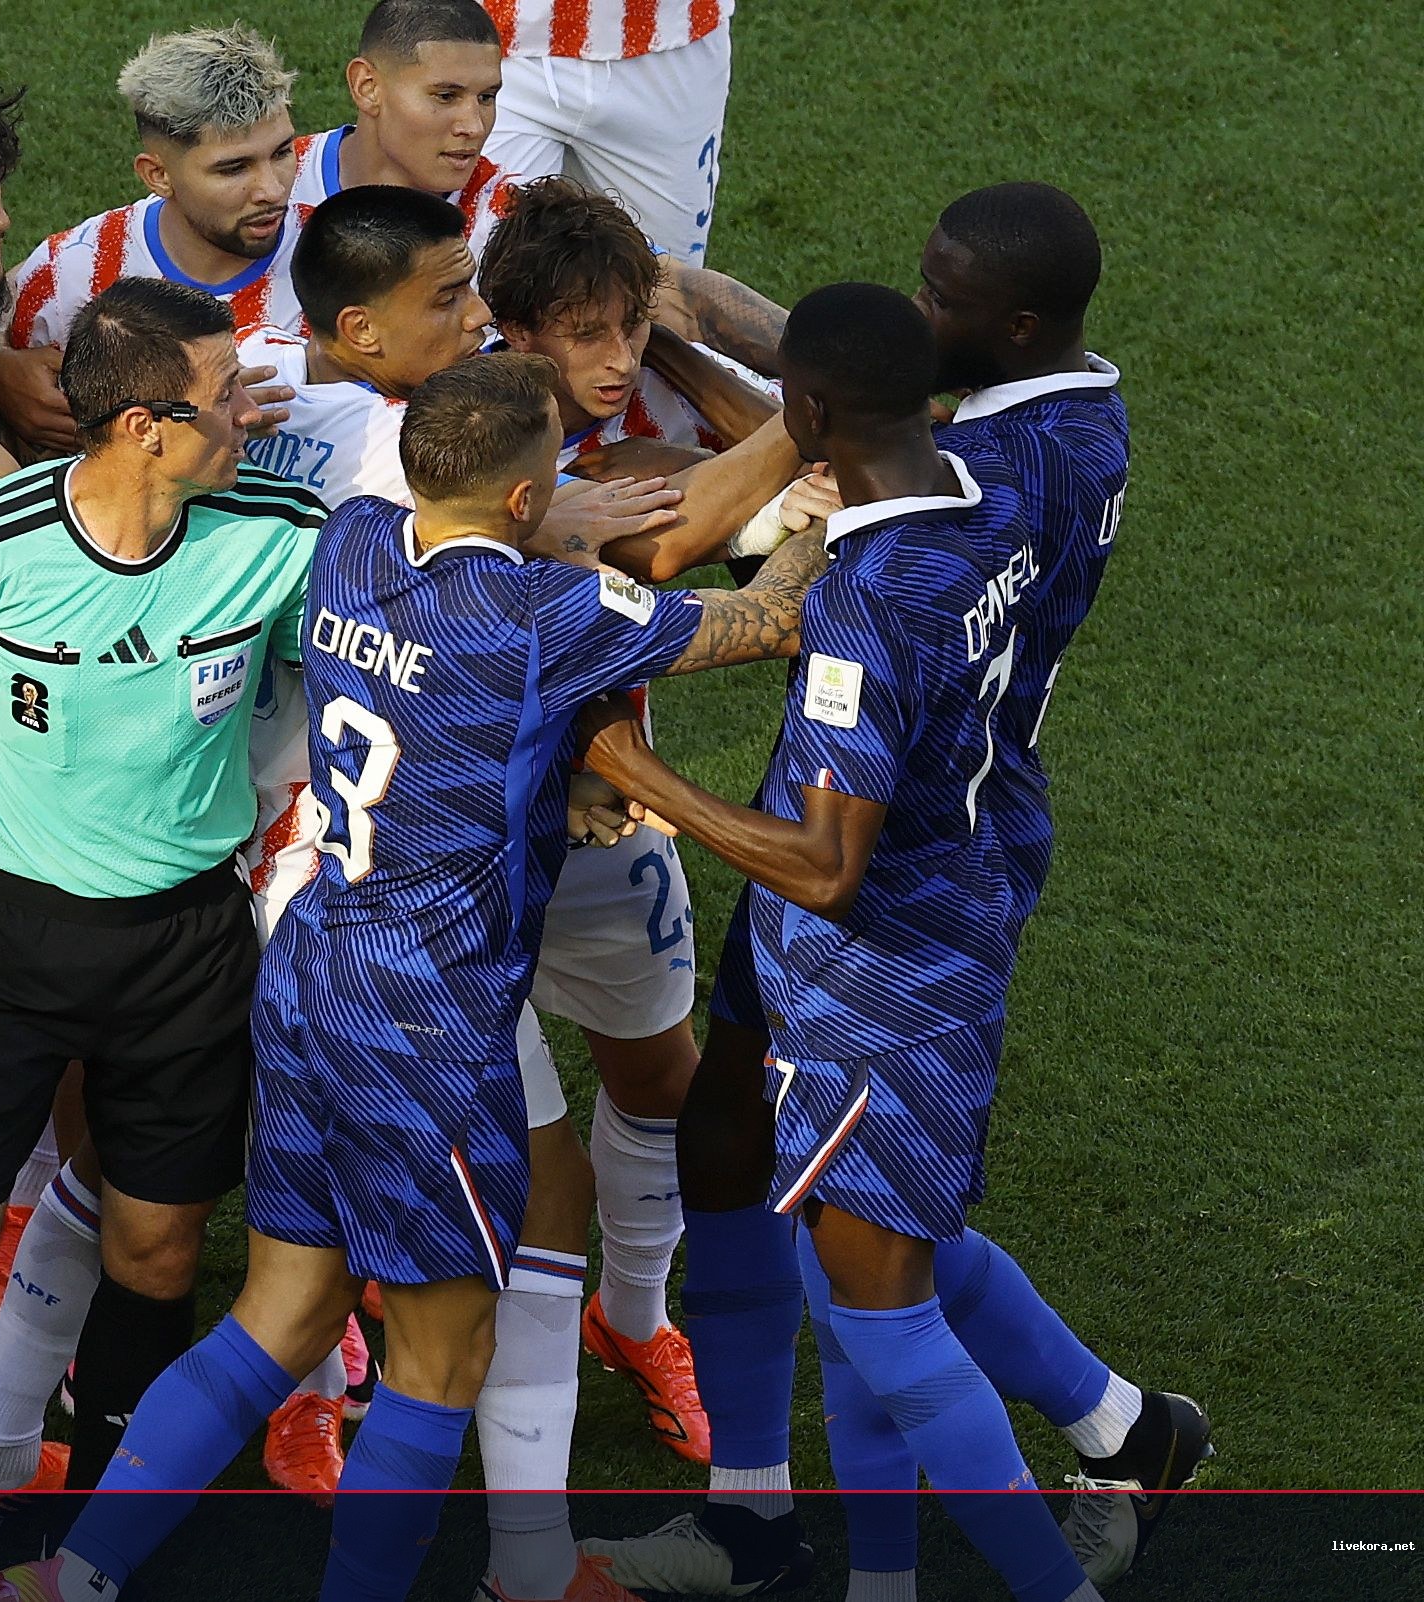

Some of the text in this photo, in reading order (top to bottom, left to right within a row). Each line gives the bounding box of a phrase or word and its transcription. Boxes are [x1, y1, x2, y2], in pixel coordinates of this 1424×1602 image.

[696, 132, 716, 228] 3
[312, 606, 434, 694] DIGNE
[197, 654, 246, 685] FIFA
[197, 679, 243, 707] REFEREE
[814, 695, 848, 712] EDUCATION
[21, 715, 40, 729] FIFA
[965, 624, 1017, 836] 7
[315, 695, 402, 884] 3
[392, 1021, 445, 1037] AERO-FIT
[774, 1057, 796, 1121] 7
[12, 1271, 61, 1307] APF
